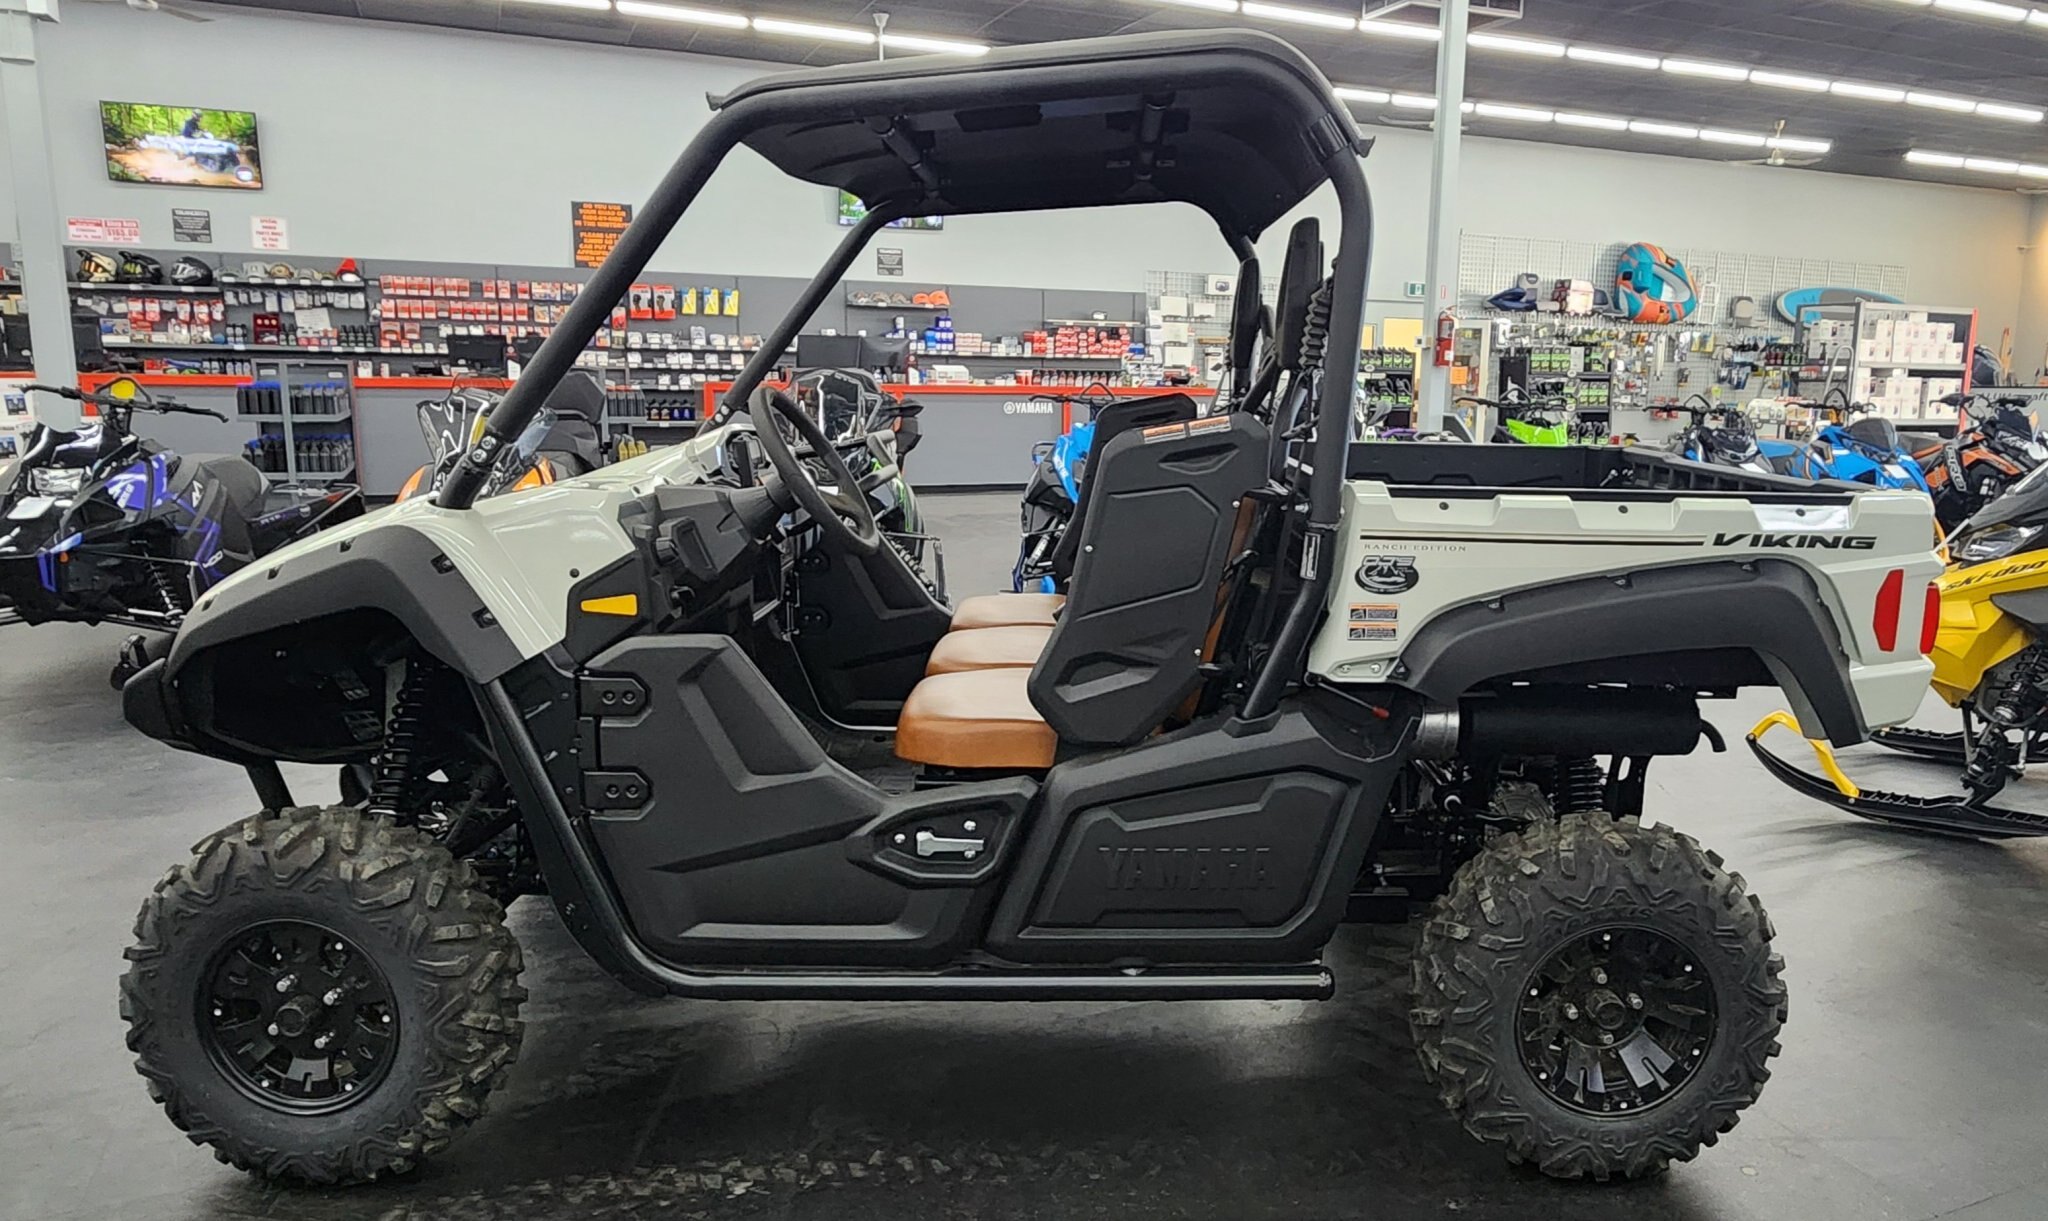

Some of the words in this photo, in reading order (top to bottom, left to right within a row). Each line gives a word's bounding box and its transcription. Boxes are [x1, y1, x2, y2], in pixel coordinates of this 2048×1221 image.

[1015, 402, 1053, 414] YAMAHA
[1364, 543, 1407, 551] RANCH
[1413, 544, 1467, 552] EDITION
[1713, 533, 1877, 550] VIKING
[1098, 847, 1277, 891] YAMAHA
